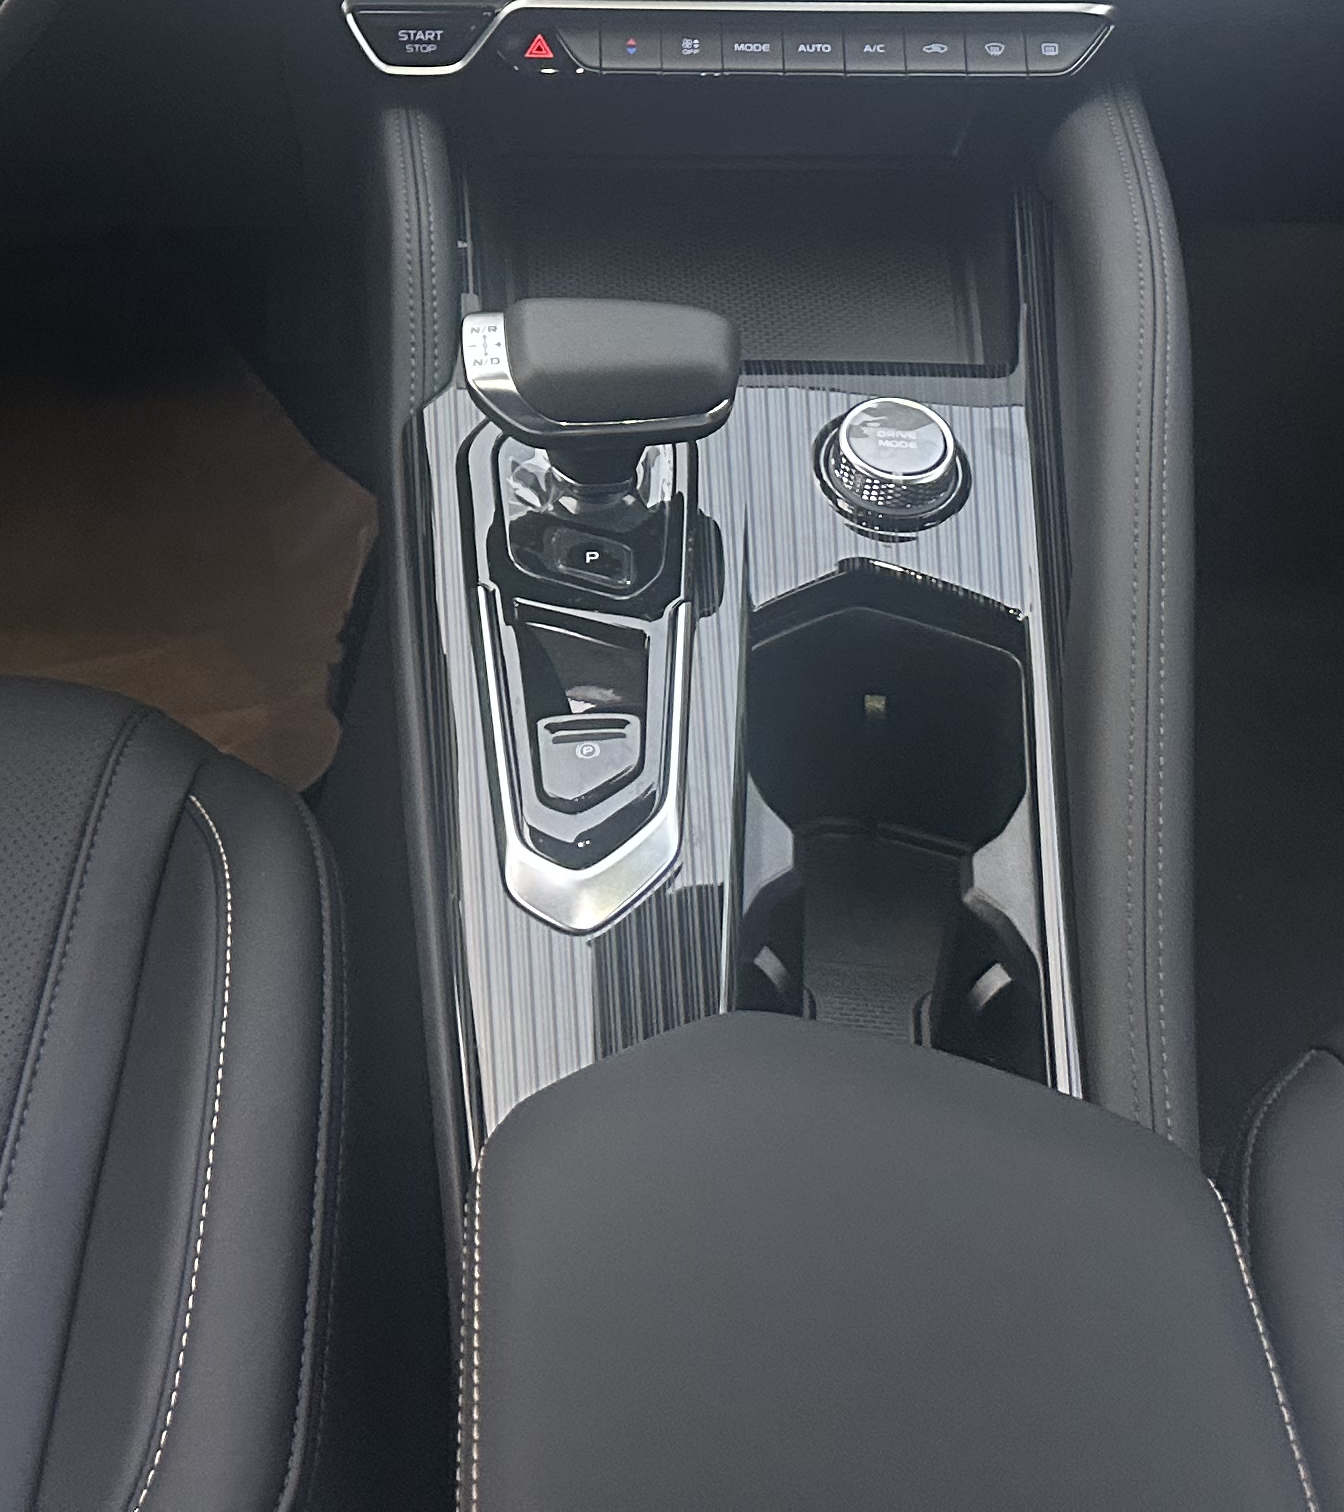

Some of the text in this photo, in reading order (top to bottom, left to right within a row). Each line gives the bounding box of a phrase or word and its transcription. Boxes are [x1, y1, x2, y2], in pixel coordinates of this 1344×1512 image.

[398, 29, 444, 41] START
[405, 43, 438, 54] STOP
[734, 43, 770, 52] MODE
[797, 43, 832, 53] AUTO
[863, 43, 886, 53] A/C
[470, 325, 498, 334] N/R
[473, 357, 501, 366] N/D
[876, 429, 917, 440] DRIVE
[878, 439, 918, 449] MODE
[585, 551, 599, 564] P
